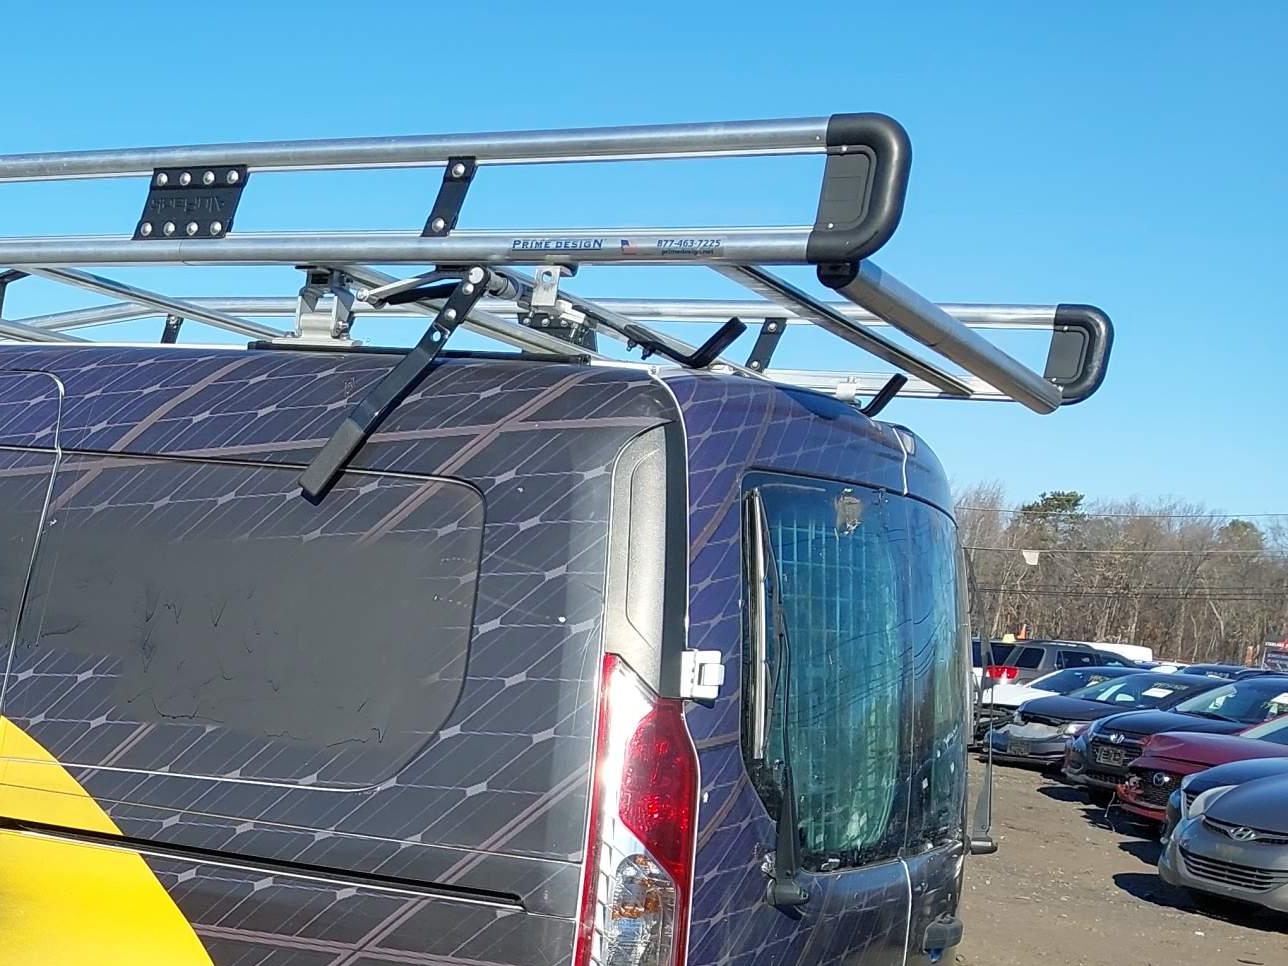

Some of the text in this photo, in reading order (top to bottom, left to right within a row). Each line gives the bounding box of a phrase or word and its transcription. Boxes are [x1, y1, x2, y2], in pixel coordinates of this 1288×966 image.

[512, 239, 604, 249] PRIME DESIGN
[656, 239, 721, 248] 877-463-7225
